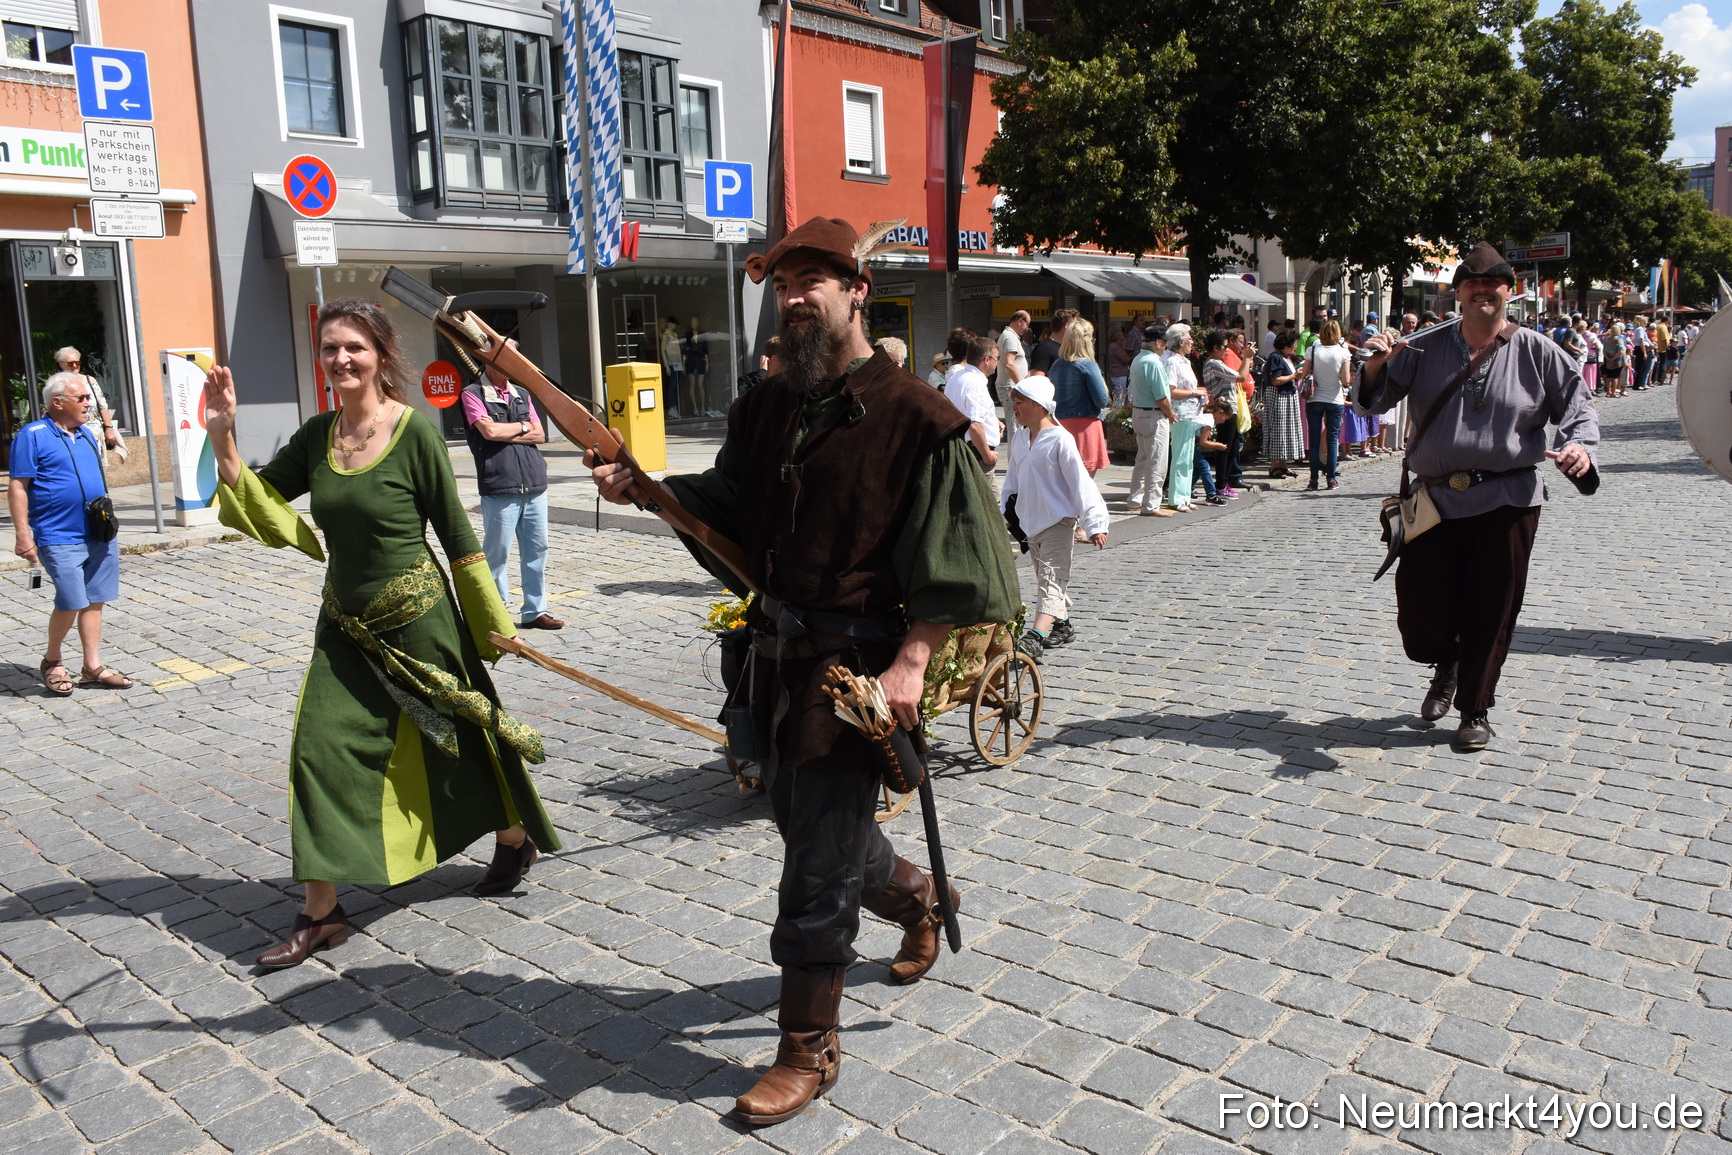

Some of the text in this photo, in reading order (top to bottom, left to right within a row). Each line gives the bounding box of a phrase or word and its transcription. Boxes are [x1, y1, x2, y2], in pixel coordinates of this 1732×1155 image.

[91, 56, 132, 110] P
[99, 129, 140, 139] nur mit
[91, 138, 151, 151] Parkschein
[97, 151, 147, 164] werktags
[94, 177, 106, 186] Sa
[716, 168, 742, 211] P
[876, 287, 890, 296] NZ
[428, 374, 456, 385] FINAL
[430, 383, 455, 395] SALE
[177, 383, 190, 416] jellyfish
